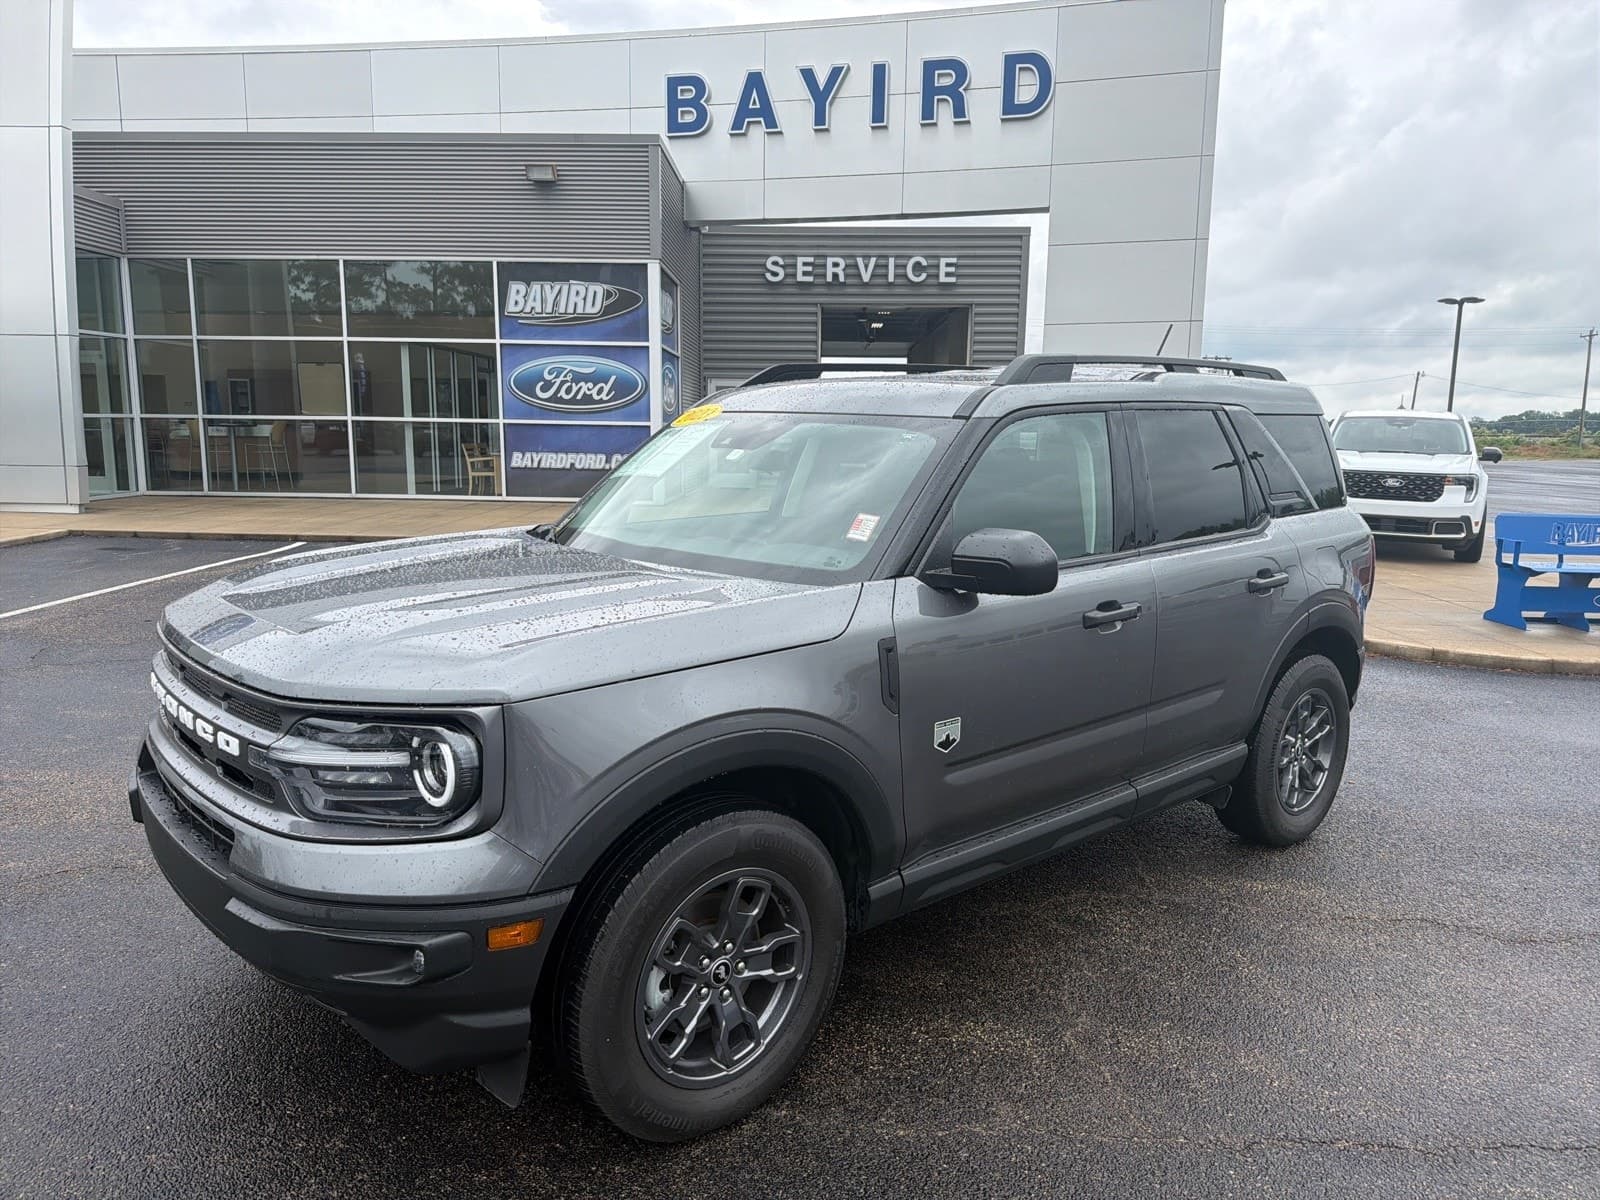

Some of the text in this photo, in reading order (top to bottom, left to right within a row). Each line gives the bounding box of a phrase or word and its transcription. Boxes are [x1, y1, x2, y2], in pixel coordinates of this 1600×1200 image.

[664, 49, 1056, 137] BAYIRD
[764, 255, 958, 283] SERVICE
[506, 281, 606, 316] BAYIRD
[535, 364, 617, 401] Ford
